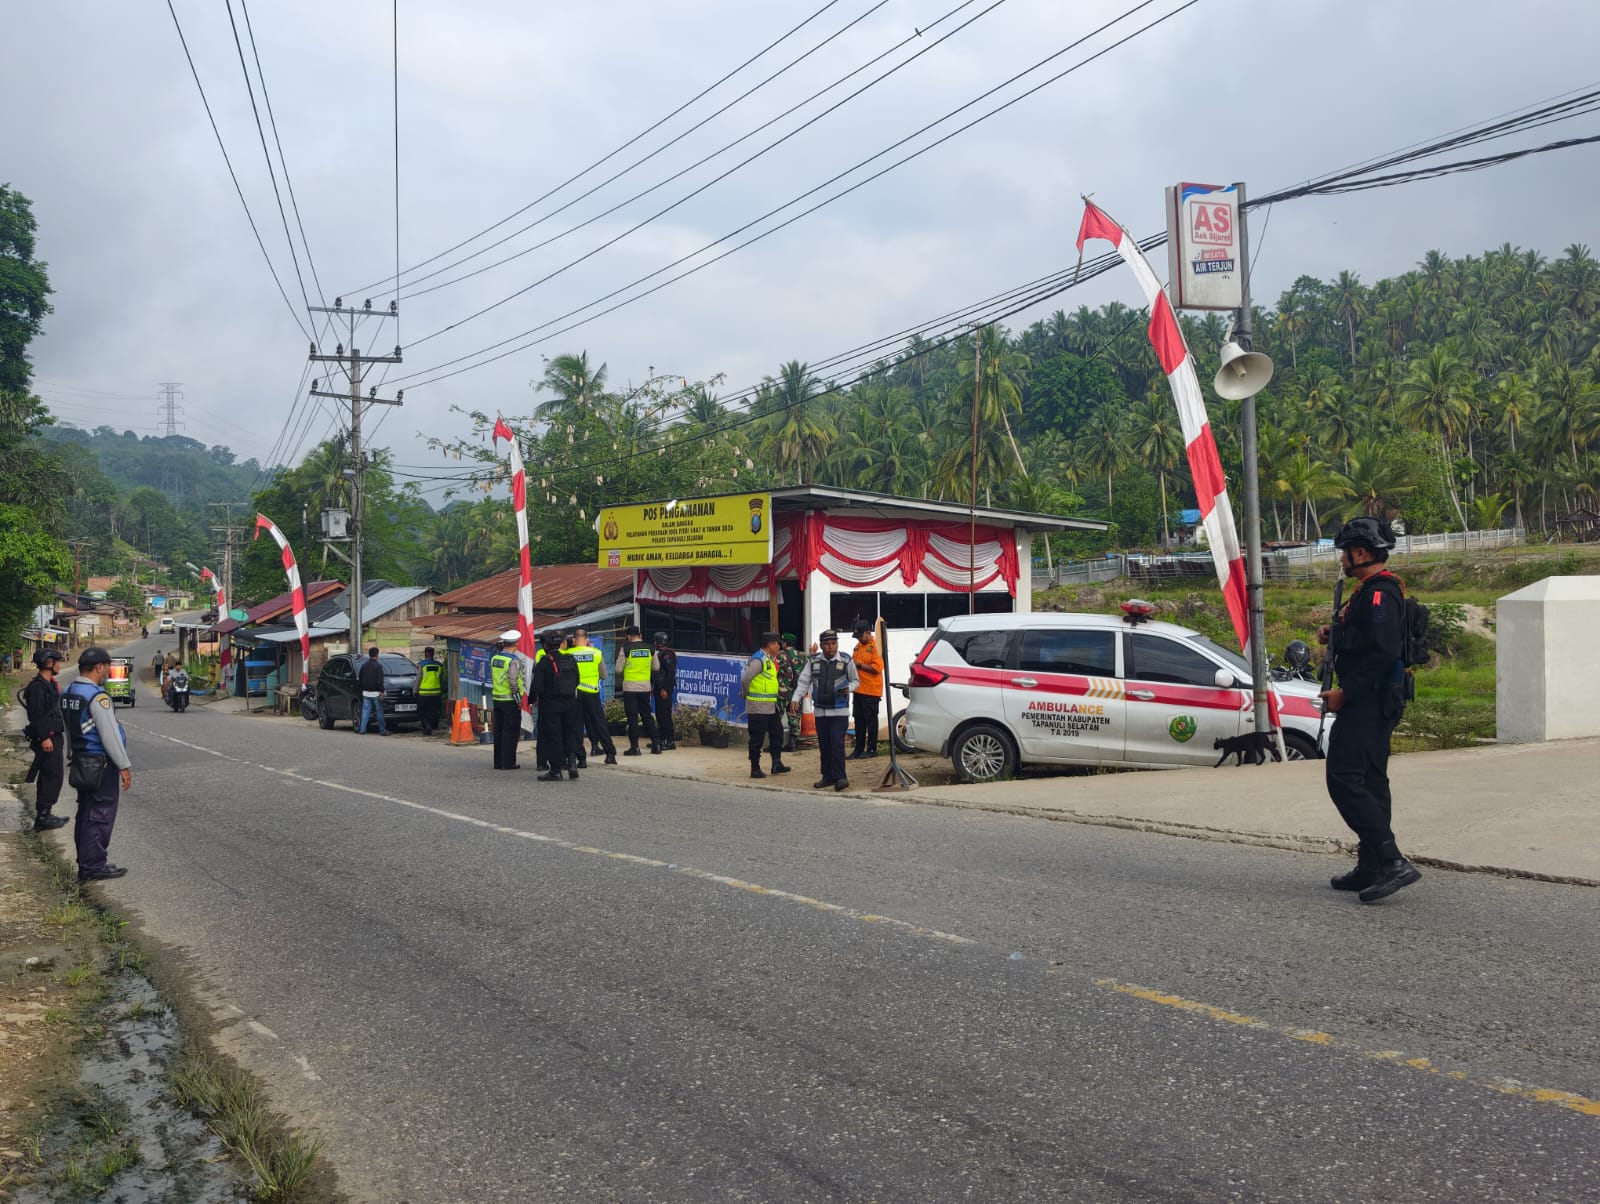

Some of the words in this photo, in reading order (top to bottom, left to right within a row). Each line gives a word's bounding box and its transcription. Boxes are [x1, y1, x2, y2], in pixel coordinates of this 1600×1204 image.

[1194, 205, 1229, 233] AS
[1196, 262, 1206, 273] AIR
[1208, 261, 1233, 272] TERJUN
[644, 508, 657, 520] POS
[660, 502, 715, 519] PENGAMANAN
[627, 553, 644, 561] MUDIK
[646, 552, 664, 561] AMAN,
[666, 552, 693, 560] KELUARGA
[676, 669, 702, 679] amanan
[704, 668, 737, 683] Perayaan
[681, 680, 698, 693] Raya
[699, 681, 712, 693] Idul
[714, 682, 729, 696] Fitri
[1028, 701, 1104, 714] AMBULANCE
[1022, 712, 1065, 721] PEMERINTAH
[1068, 715, 1110, 724] KABUPATEN
[1032, 720, 1065, 728] TAPANULI
[1068, 723, 1099, 731] SELATAN
